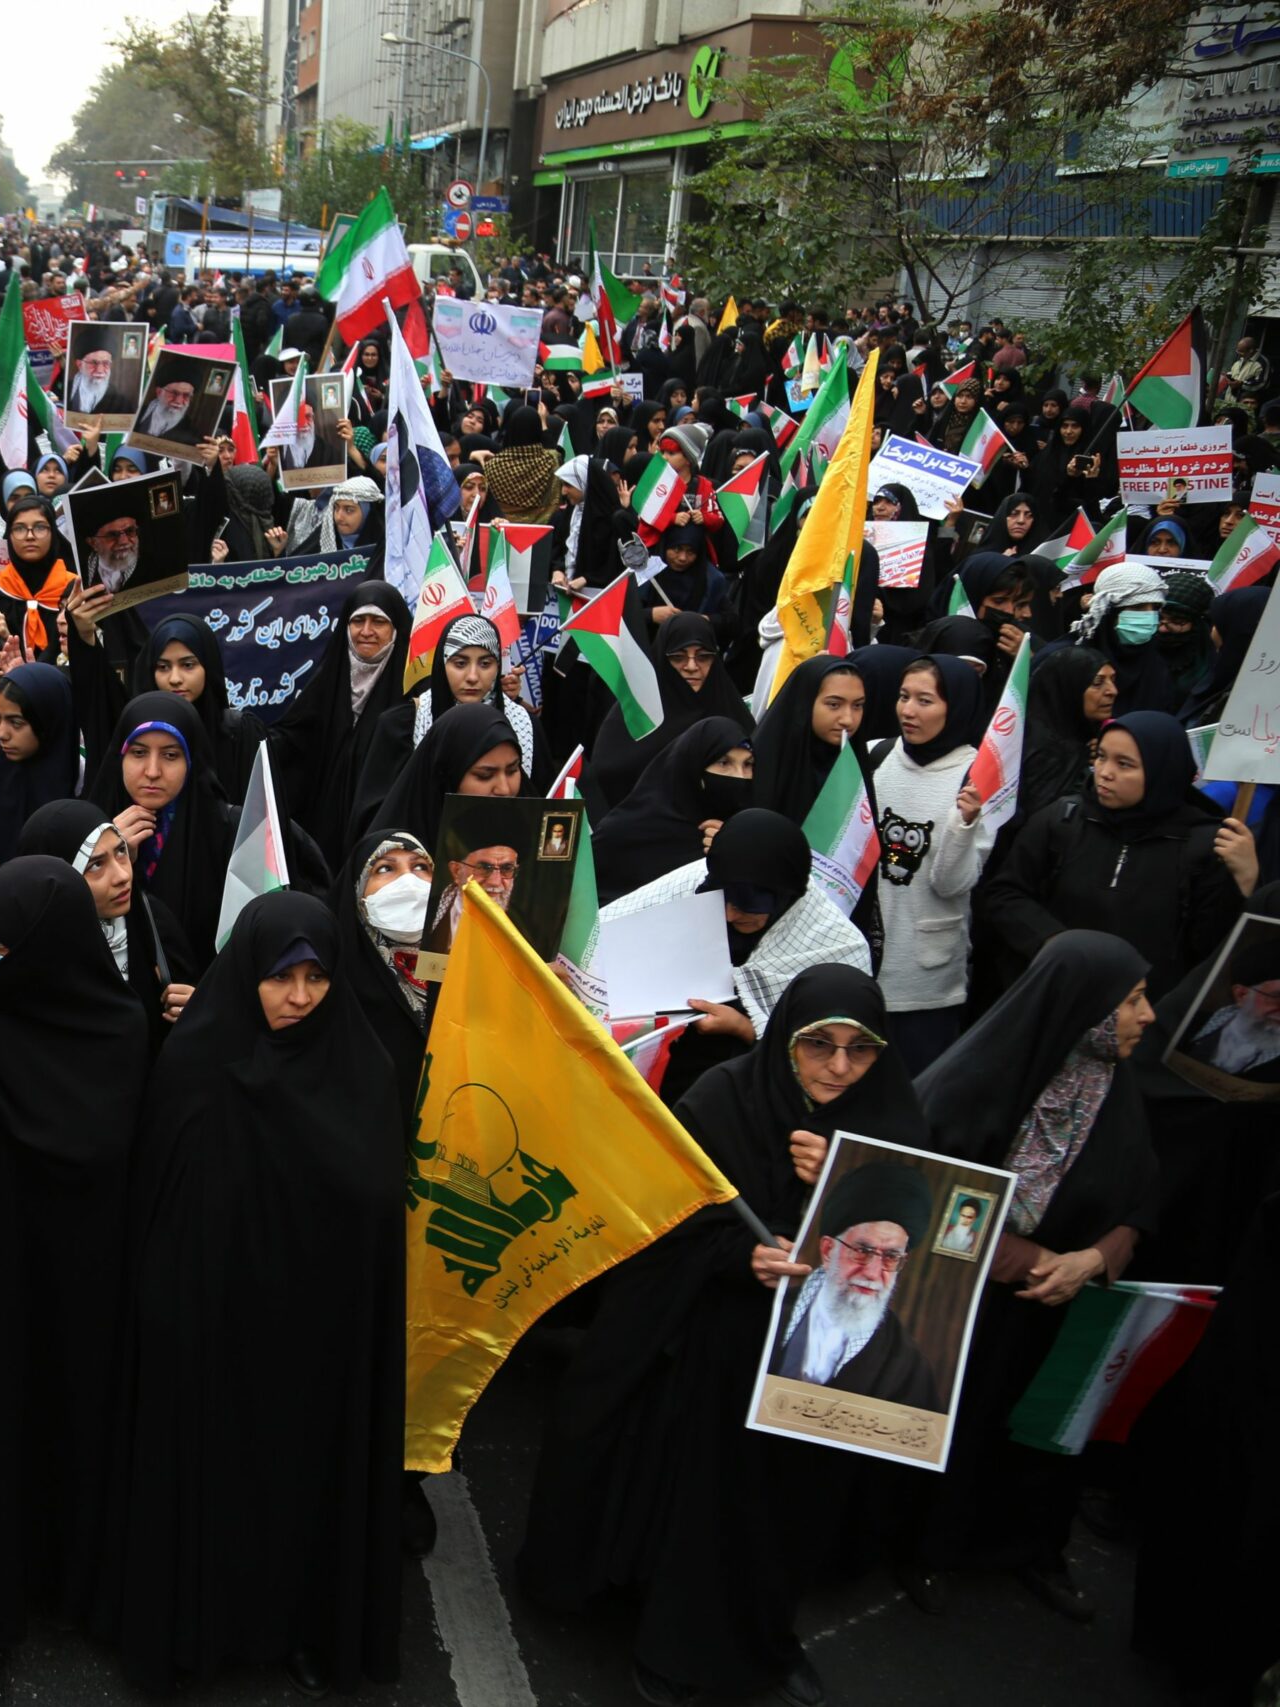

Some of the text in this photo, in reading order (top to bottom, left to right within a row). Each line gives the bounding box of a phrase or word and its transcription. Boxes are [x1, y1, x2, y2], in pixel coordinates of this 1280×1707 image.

[555, 72, 682, 129] بانک قرض الحسنه مهر ایران
[883, 443, 929, 464] آمریکا
[923, 455, 941, 471] بر
[941, 459, 973, 479] مرگ
[1121, 463, 1155, 476] مظلومند
[1181, 461, 1201, 474] غزه
[1202, 462, 1230, 474] مردم
[1123, 477, 1230, 492] FREE PASTINE
[217, 577, 236, 589] به
[237, 566, 284, 588] خطاب
[286, 562, 338, 583] رهبری
[226, 595, 274, 642] کشور
[283, 605, 330, 641] فردای
[255, 616, 283, 648] این
[269, 659, 314, 705] کشور
